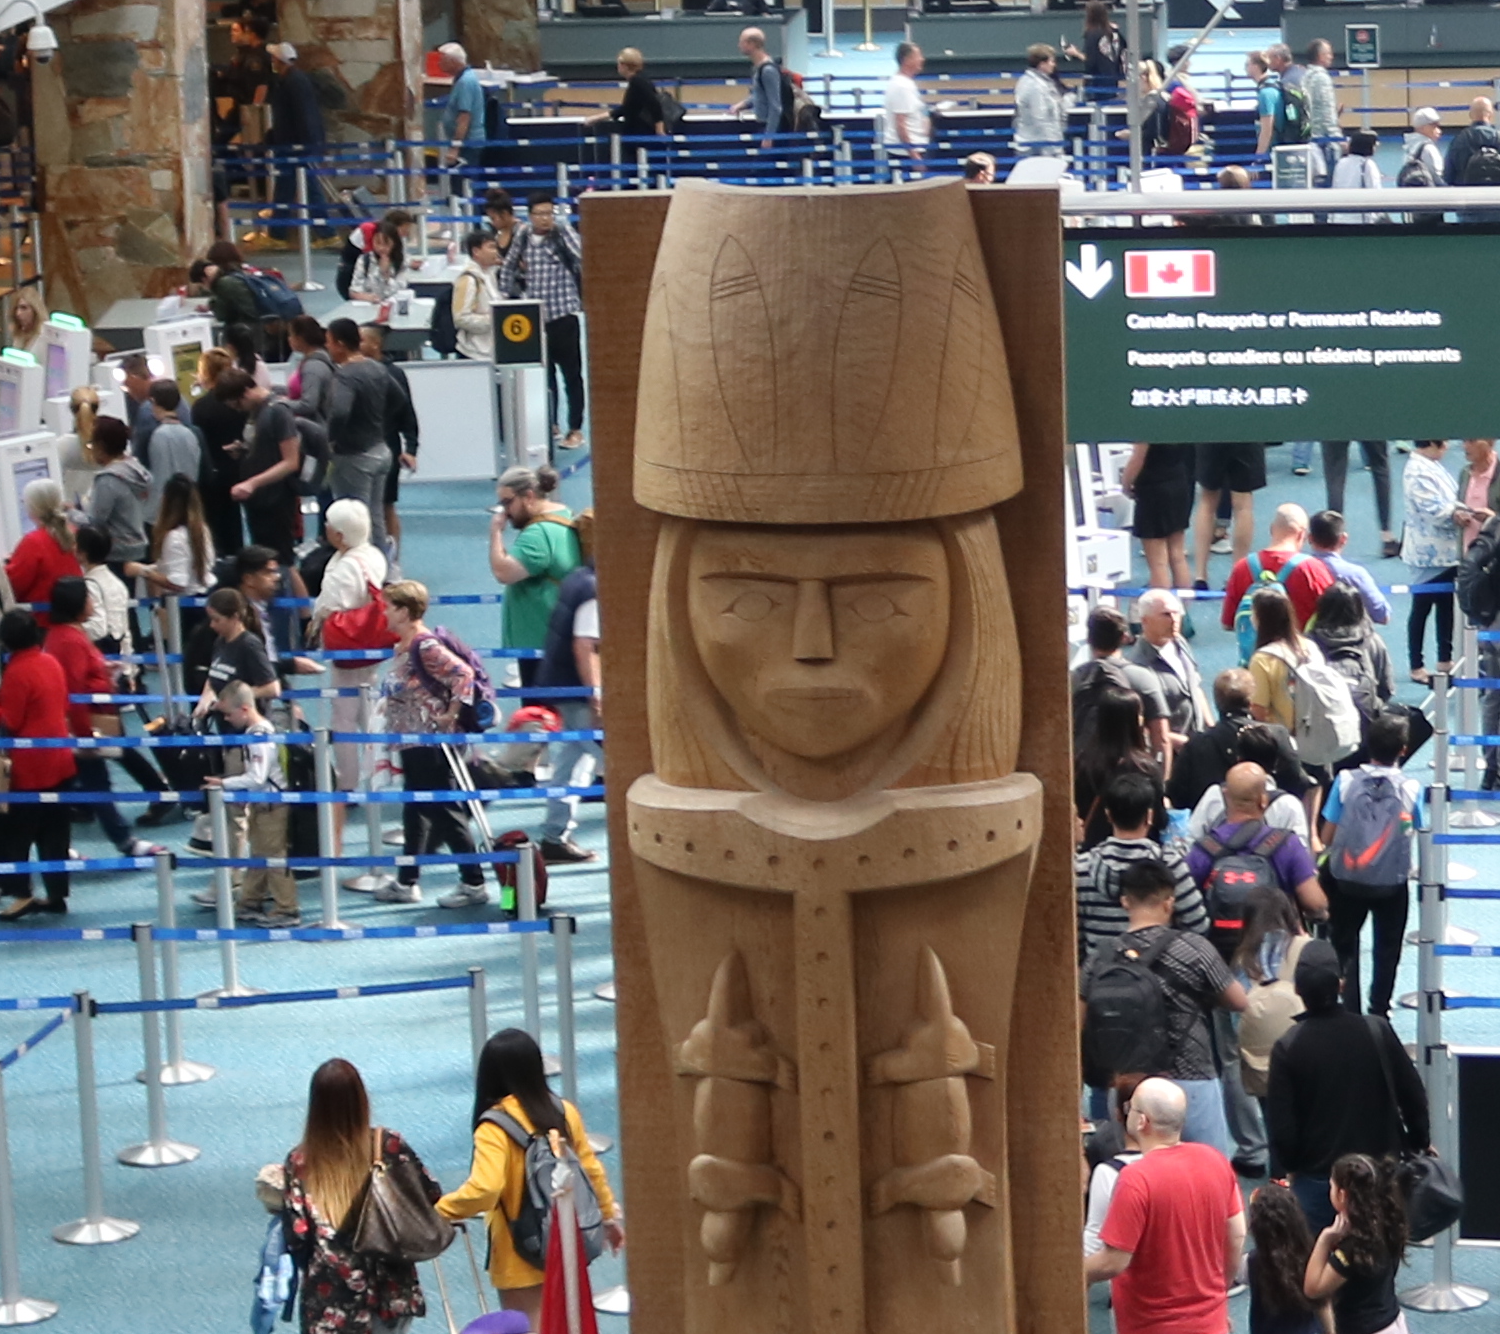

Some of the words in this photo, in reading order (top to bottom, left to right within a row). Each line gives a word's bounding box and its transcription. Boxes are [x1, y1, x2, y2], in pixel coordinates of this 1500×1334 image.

[510, 320, 522, 335] 6
[1126, 313, 1195, 329] Canadian
[1197, 313, 1267, 331] Passports
[1269, 316, 1286, 327] or
[1288, 312, 1368, 327] Permanent
[1370, 310, 1441, 326] Residents
[1127, 350, 1206, 367] Passeports
[1207, 349, 1281, 365] canadiens
[1283, 351, 1303, 364] ou
[1305, 347, 1372, 364] résidents
[1374, 348, 1462, 366] permanents
